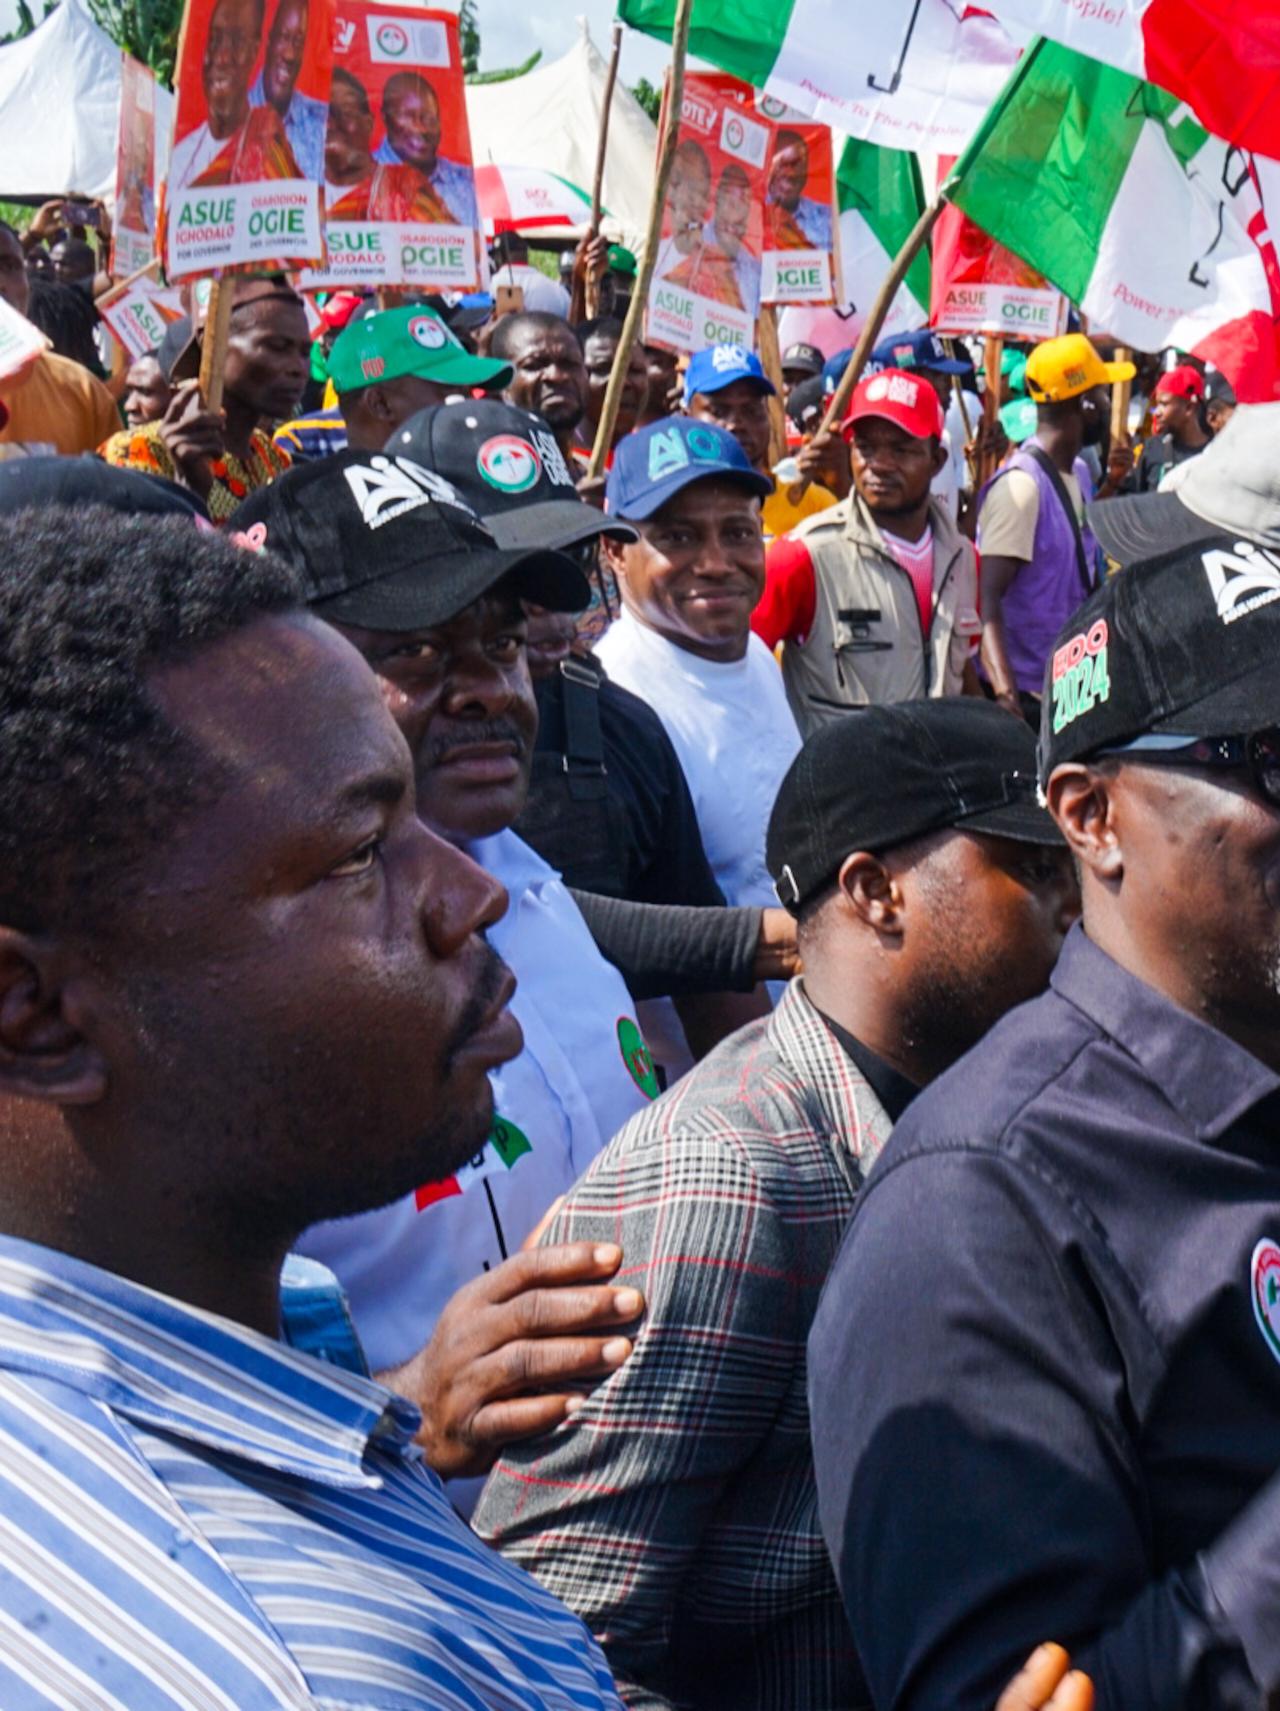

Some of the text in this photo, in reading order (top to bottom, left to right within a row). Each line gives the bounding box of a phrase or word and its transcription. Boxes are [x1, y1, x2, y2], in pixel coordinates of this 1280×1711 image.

[178, 198, 236, 228] ASUE
[248, 207, 305, 236] OGIE
[175, 225, 235, 245] IGHODALO
[327, 231, 382, 251] SUE
[401, 245, 464, 267] OGIE
[655, 288, 695, 319] ASUE
[945, 289, 987, 305] ASUE
[1001, 303, 1050, 322] OGIE
[703, 320, 745, 347] OGIE
[1053, 619, 1108, 684] EDO
[1053, 646, 1111, 735] 2024
